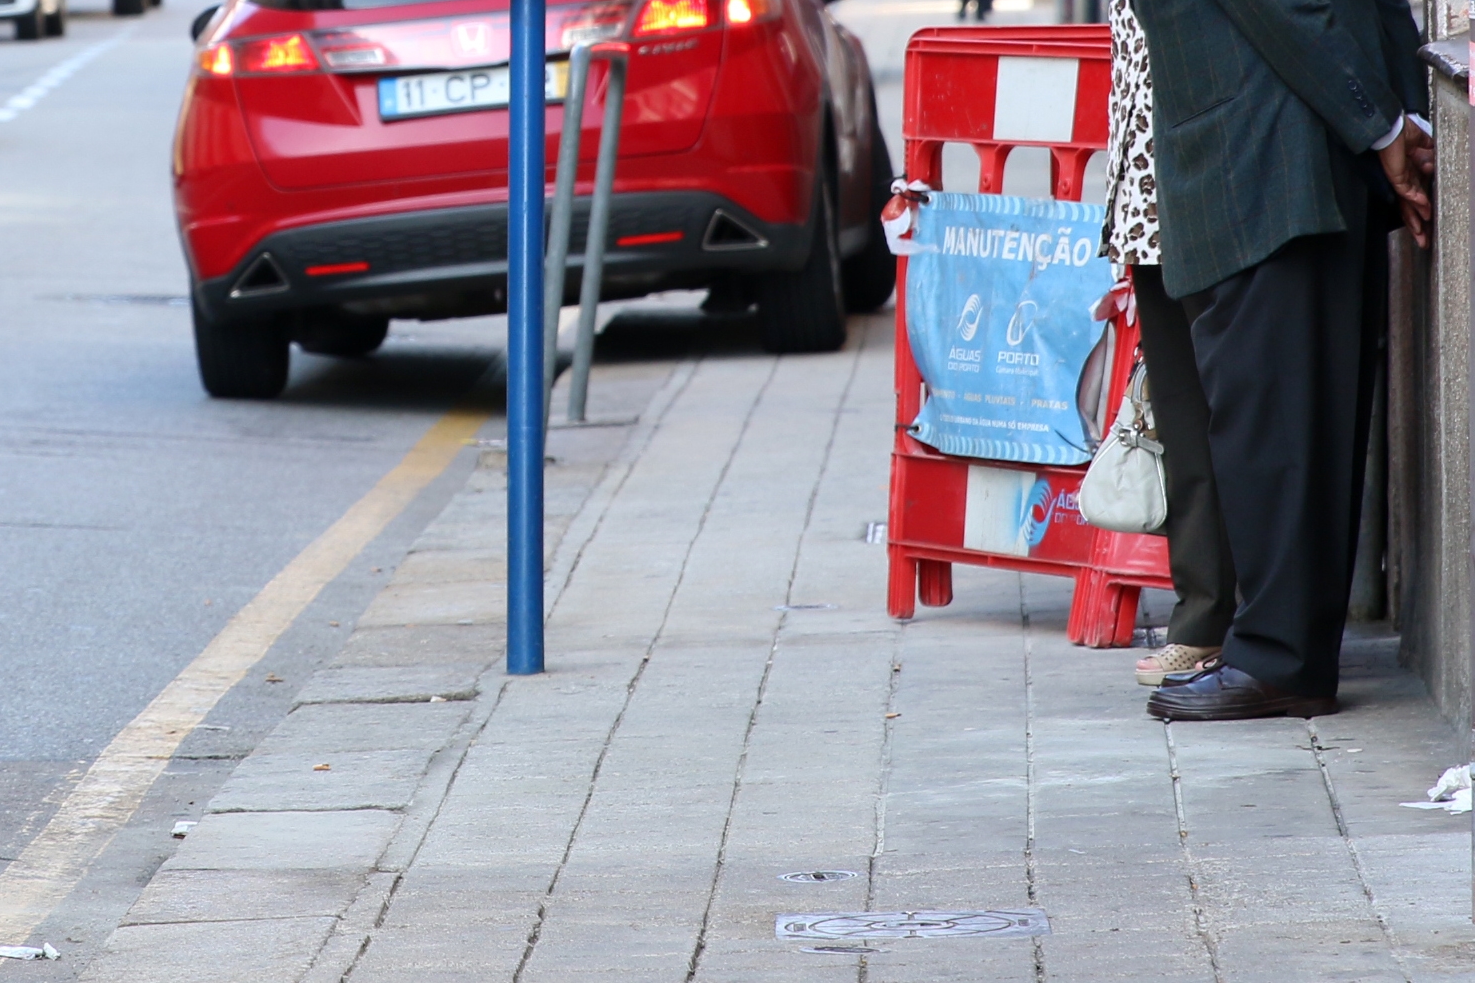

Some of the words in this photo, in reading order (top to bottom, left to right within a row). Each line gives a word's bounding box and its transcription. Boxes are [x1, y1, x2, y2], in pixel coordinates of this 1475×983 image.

[942, 224, 1092, 271] MANUTENÇÃO
[948, 345, 982, 363] ÁGUAS
[997, 350, 1040, 366] PORTO
[959, 362, 980, 374] PORTO
[1017, 423, 1050, 432] EMPRESA
